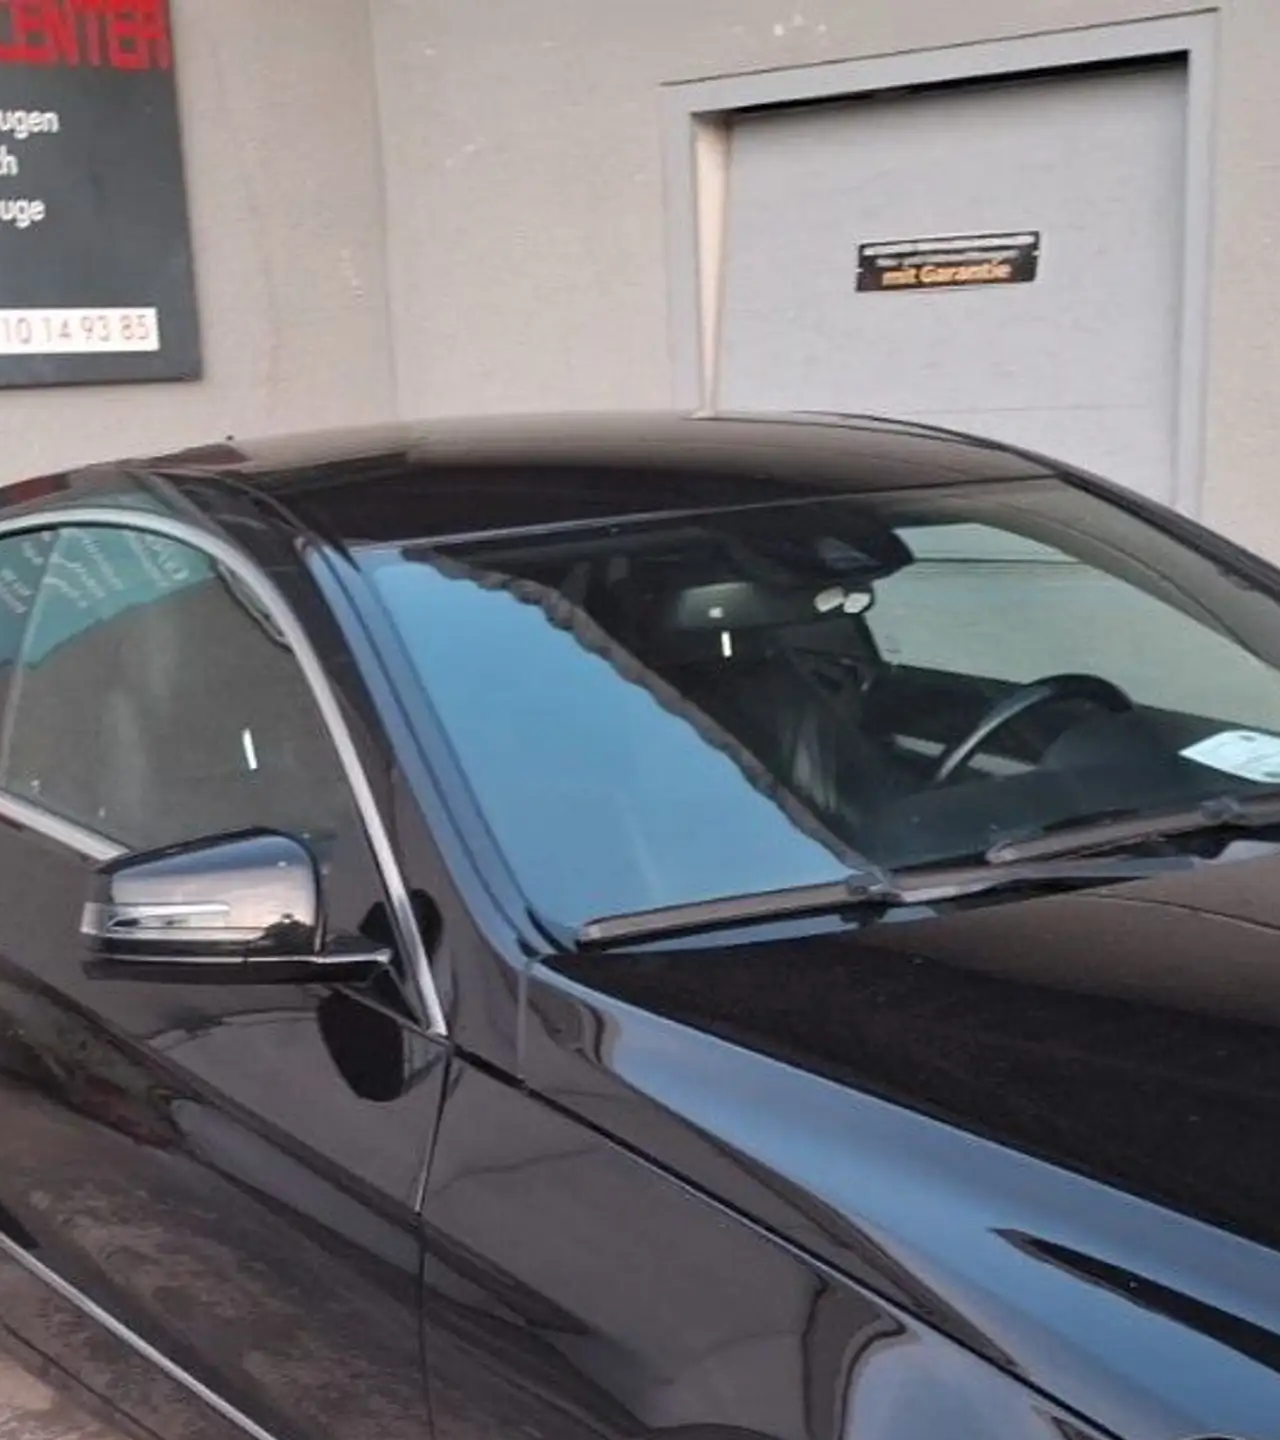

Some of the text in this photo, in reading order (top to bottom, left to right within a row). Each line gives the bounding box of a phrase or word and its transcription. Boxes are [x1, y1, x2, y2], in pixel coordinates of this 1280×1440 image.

[1, 316, 33, 345] 10
[41, 316, 73, 343] 14
[79, 314, 111, 342] 93
